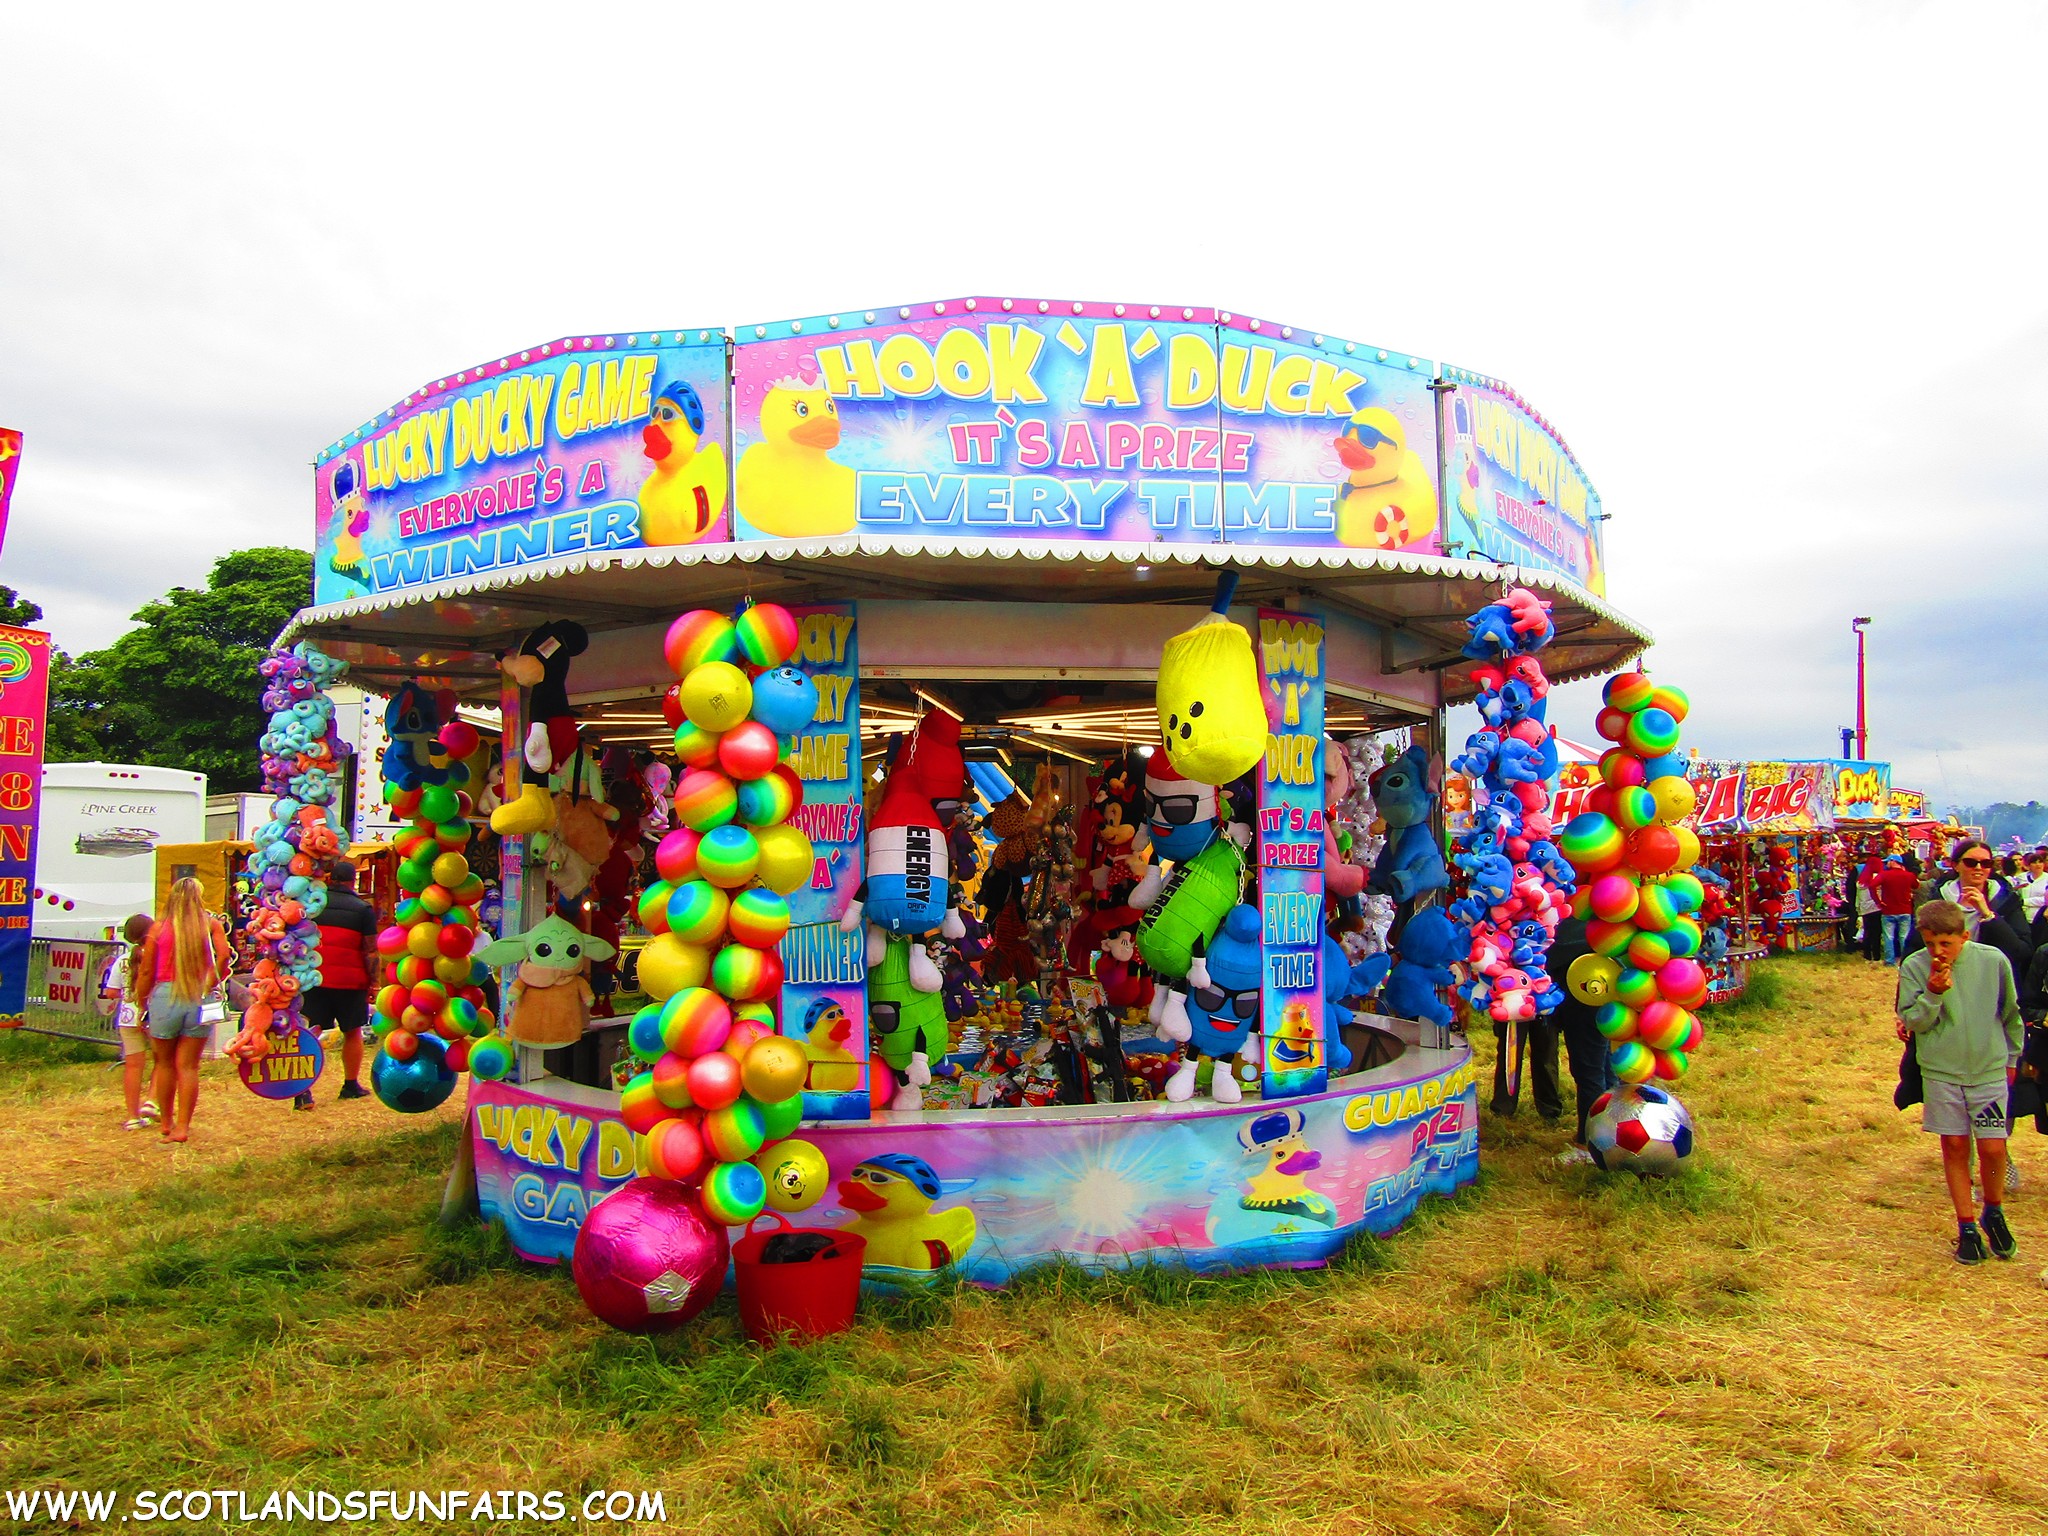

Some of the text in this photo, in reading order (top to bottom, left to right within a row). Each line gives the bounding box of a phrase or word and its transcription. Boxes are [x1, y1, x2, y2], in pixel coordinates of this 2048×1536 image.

[816, 323, 1048, 405] HOOK
[1167, 333, 1367, 417] DUCK
[362, 354, 660, 490] LUCKY DUCKY GAME
[1058, 419, 1099, 469] A
[1106, 421, 1255, 473] PRIZE
[580, 460, 605, 495] A
[1472, 393, 1588, 530] LUCKY DUCKY GAME
[857, 470, 1339, 534] EVERY TIME
[370, 499, 642, 592] WINNER
[1568, 540, 1576, 567] A
[1259, 618, 1325, 678] HOOK
[1265, 733, 1318, 785] DUCK
[88, 803, 158, 814] PINE CREEK
[1697, 773, 1810, 827] A BAG
[1839, 768, 1880, 806] DUCK
[1307, 808, 1324, 832] A
[905, 825, 931, 904] ENERGY
[1263, 844, 1319, 866] PRIZE
[1143, 866, 1193, 930] ENERGY
[1263, 892, 1321, 945] EVERY
[52, 950, 85, 970] WIN
[61, 971, 72, 981] OR
[780, 922, 864, 984] WINNER
[1270, 953, 1314, 988] TIME
[49, 983, 82, 1004] BUY
[266, 1055, 315, 1081] WIN
[477, 1103, 592, 1172] LUCKY
